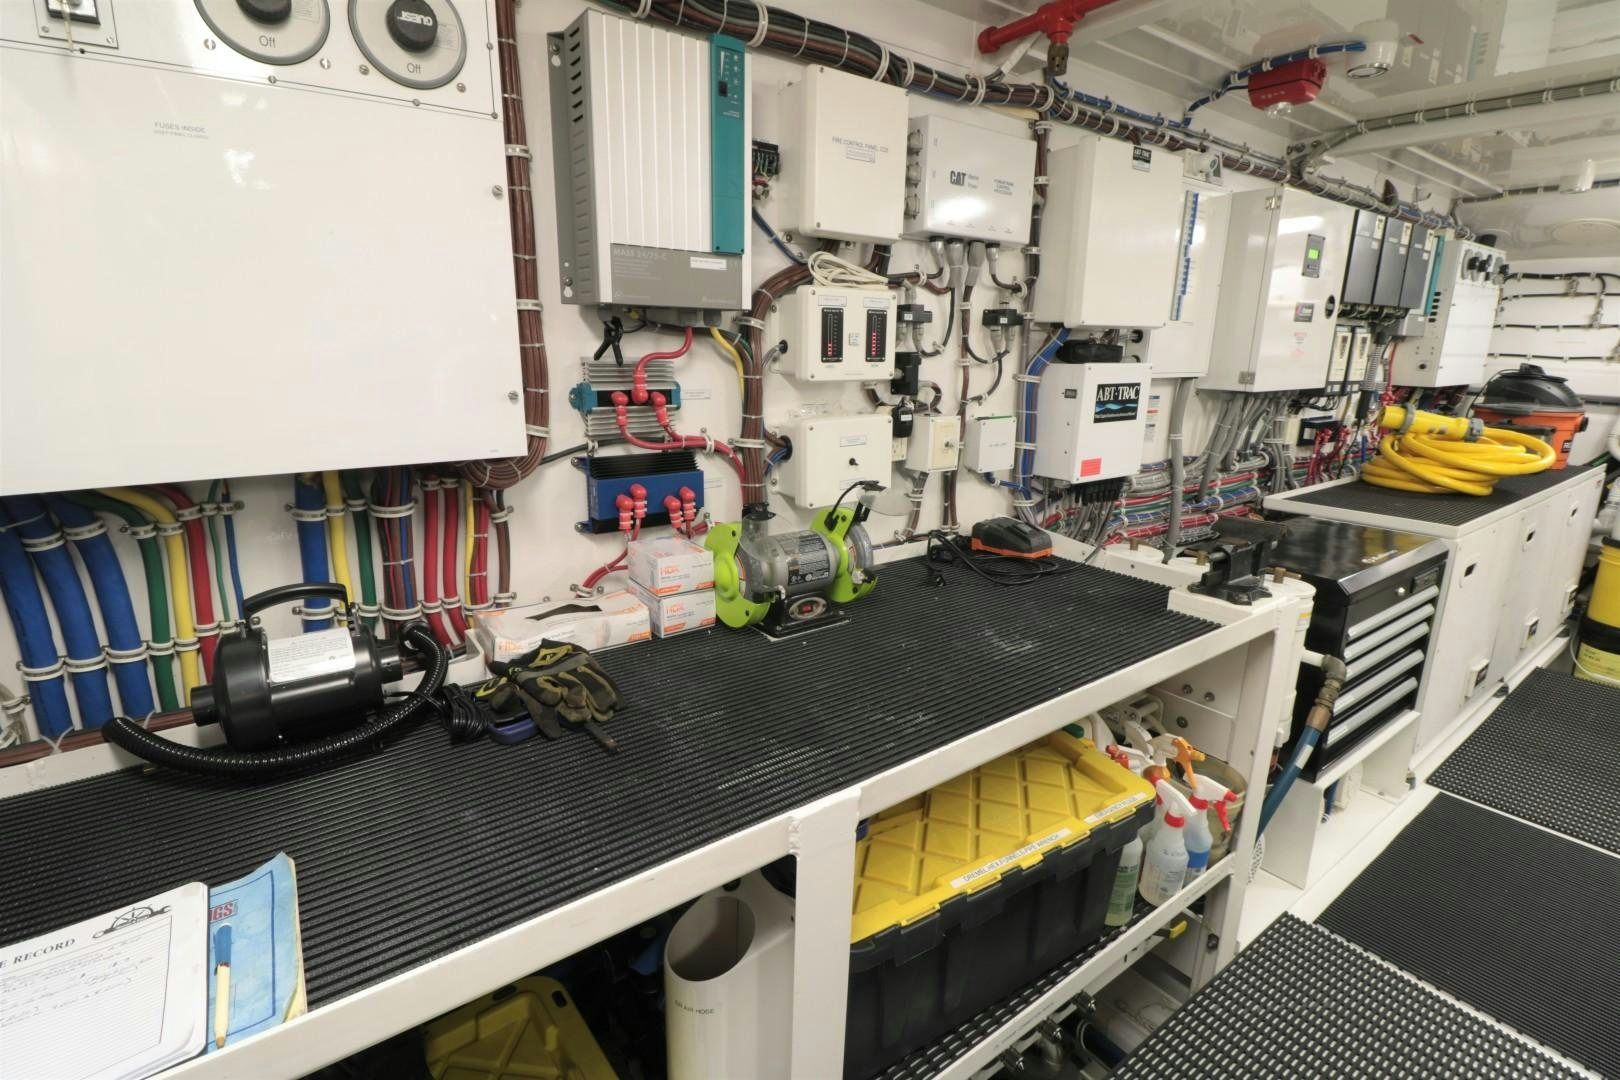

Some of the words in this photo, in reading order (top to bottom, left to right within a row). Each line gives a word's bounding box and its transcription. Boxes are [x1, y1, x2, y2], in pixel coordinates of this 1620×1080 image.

[258, 35, 276, 48] Off
[407, 63, 422, 74] Off
[950, 170, 967, 187] CAT
[613, 248, 635, 257] MASS
[13, 938, 76, 964] RECORD
